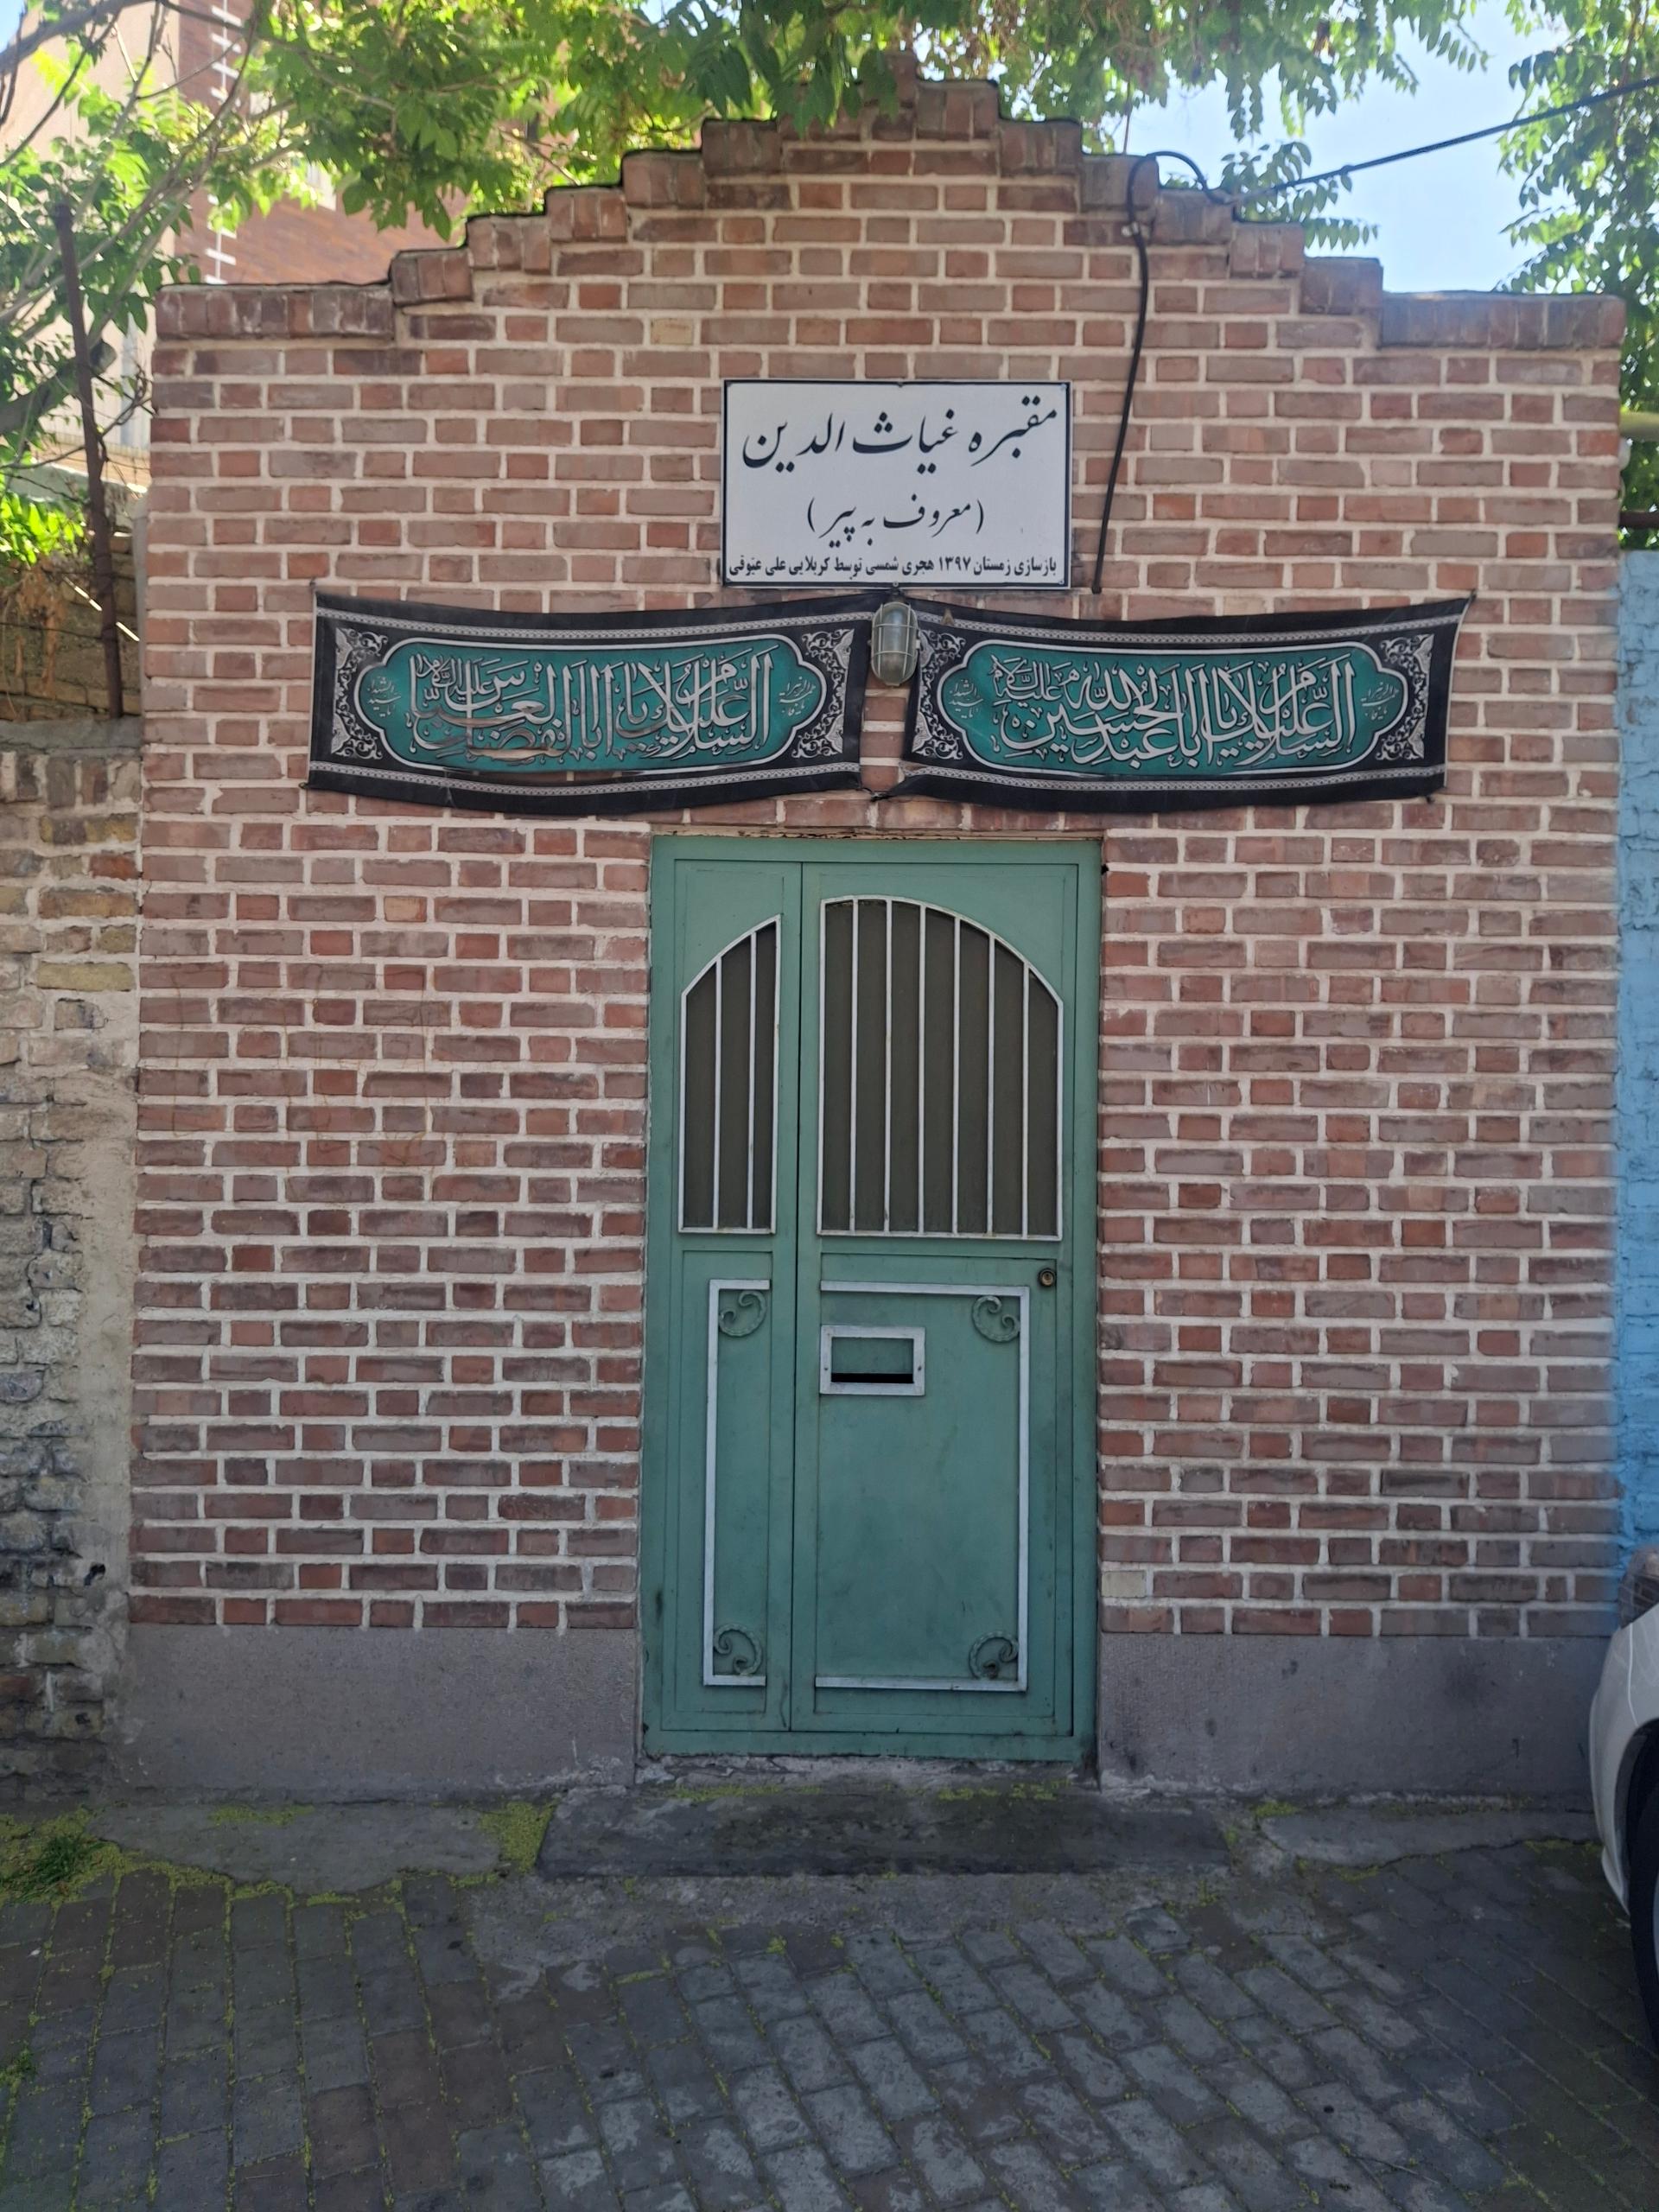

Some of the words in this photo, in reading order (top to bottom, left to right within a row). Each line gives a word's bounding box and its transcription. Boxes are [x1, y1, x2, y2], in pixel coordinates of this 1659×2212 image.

[852, 409, 959, 474] غیاث
[969, 395, 1058, 467] مقبره
[741, 411, 846, 474] الدین
[807, 497, 857, 549] پیر)
[883, 493, 985, 537] (معروف
[861, 515, 876, 546] به
[765, 556, 786, 576] علی
[788, 555, 831, 576] کربلایی
[834, 556, 863, 580] توسط
[865, 556, 899, 576] شمسی
[901, 559, 935, 575] هجری
[938, 556, 971, 572] ۱۳۹۷
[973, 556, 1011, 576] زمستان
[1014, 556, 1058, 577] بازسازی
